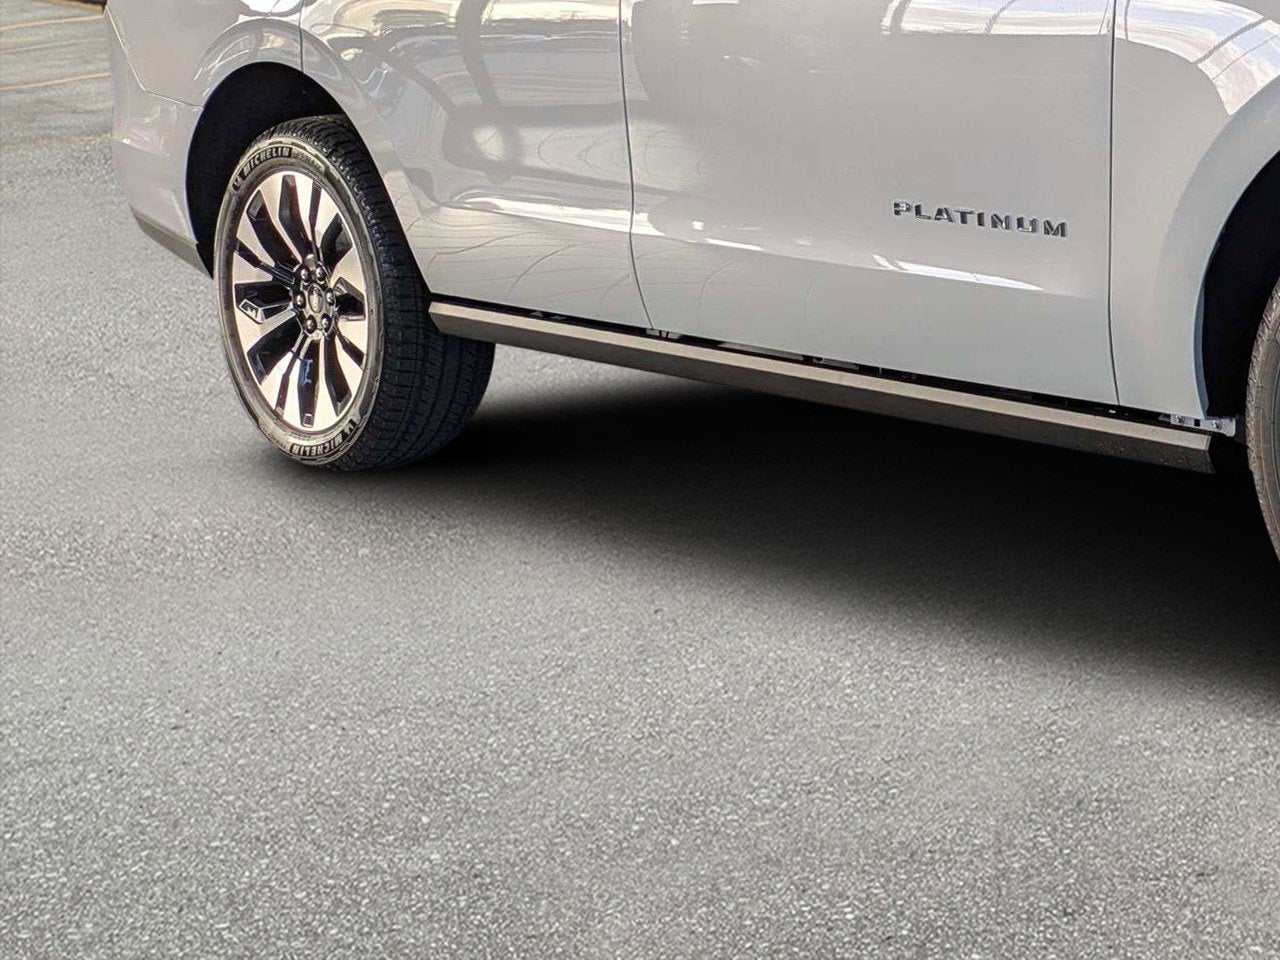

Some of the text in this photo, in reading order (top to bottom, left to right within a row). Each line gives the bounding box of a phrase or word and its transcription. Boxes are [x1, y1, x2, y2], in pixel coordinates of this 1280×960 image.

[243, 147, 291, 177] MICHELIN
[892, 200, 1068, 238] PLATINUM
[291, 433, 343, 456] MICHELIN
